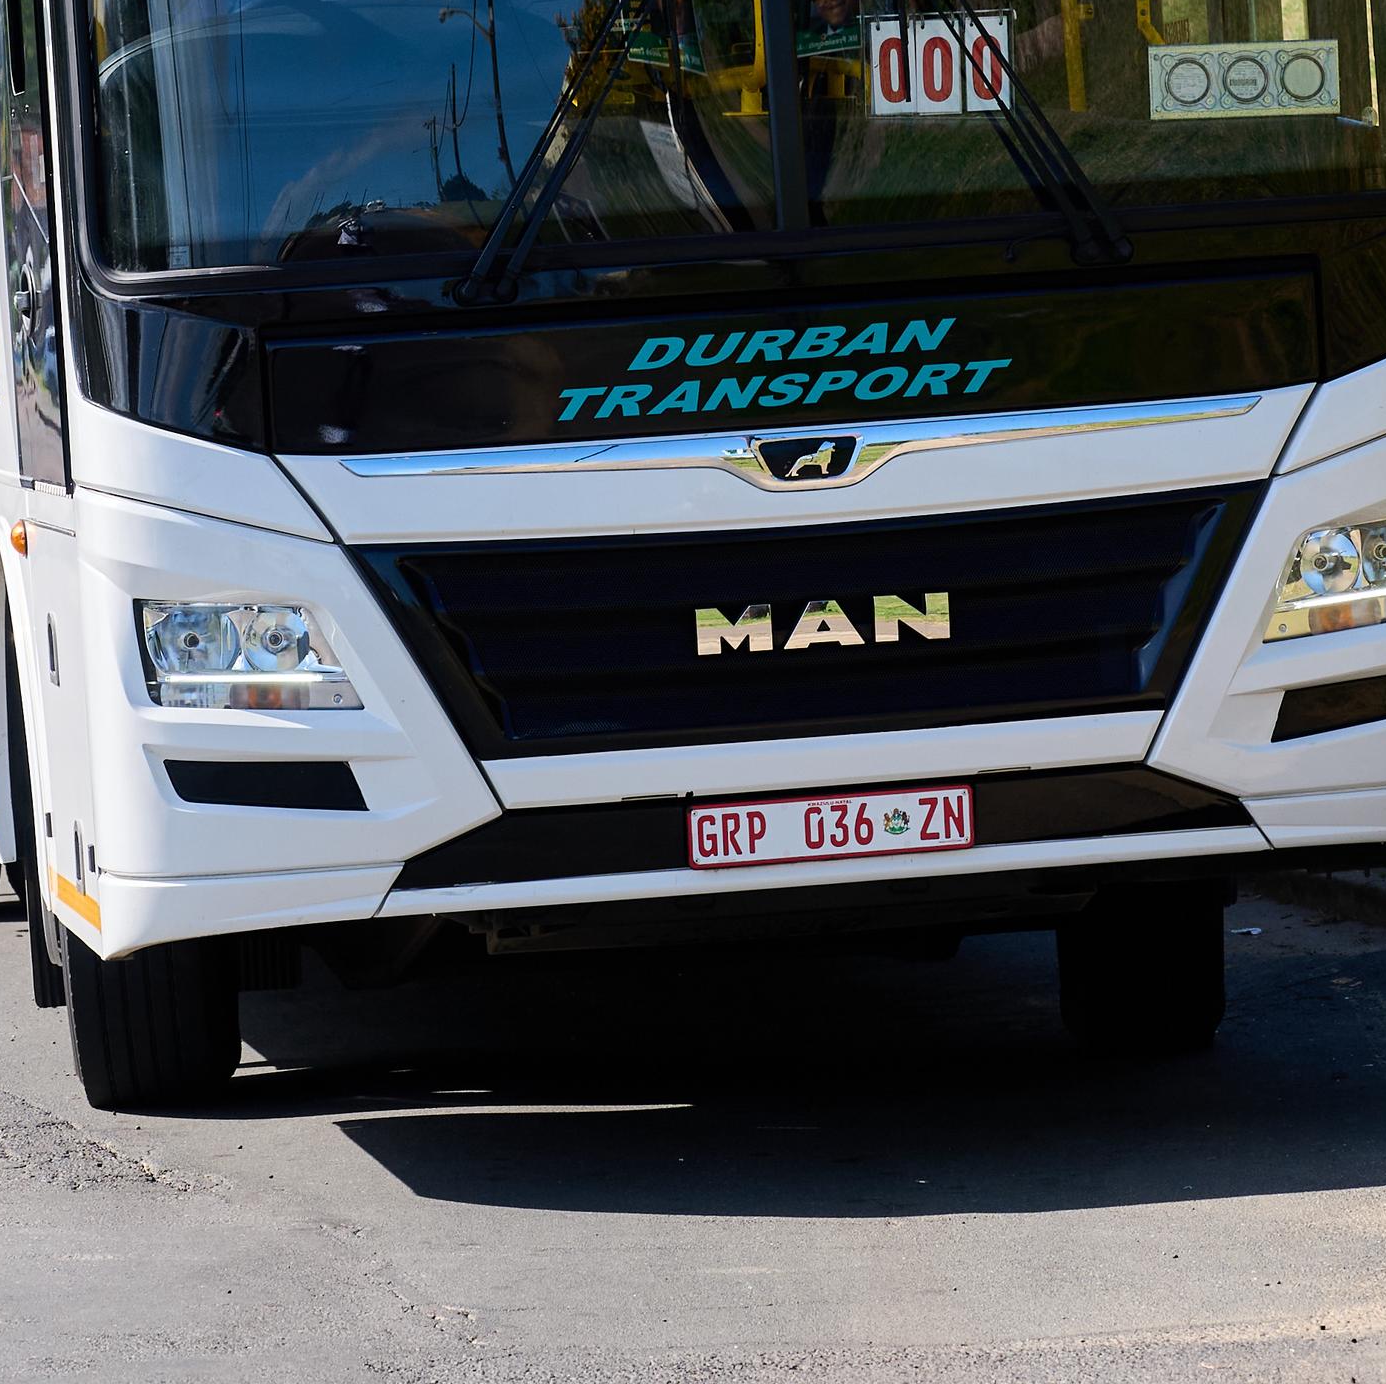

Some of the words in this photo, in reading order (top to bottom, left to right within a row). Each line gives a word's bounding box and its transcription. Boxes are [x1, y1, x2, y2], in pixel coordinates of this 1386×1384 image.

[627, 318, 956, 370] DURBAN
[557, 359, 1012, 421] TRANSPORT
[695, 592, 950, 655] MAN
[697, 811, 766, 857] GRP
[804, 803, 874, 849] 036
[919, 796, 964, 840] ZN
